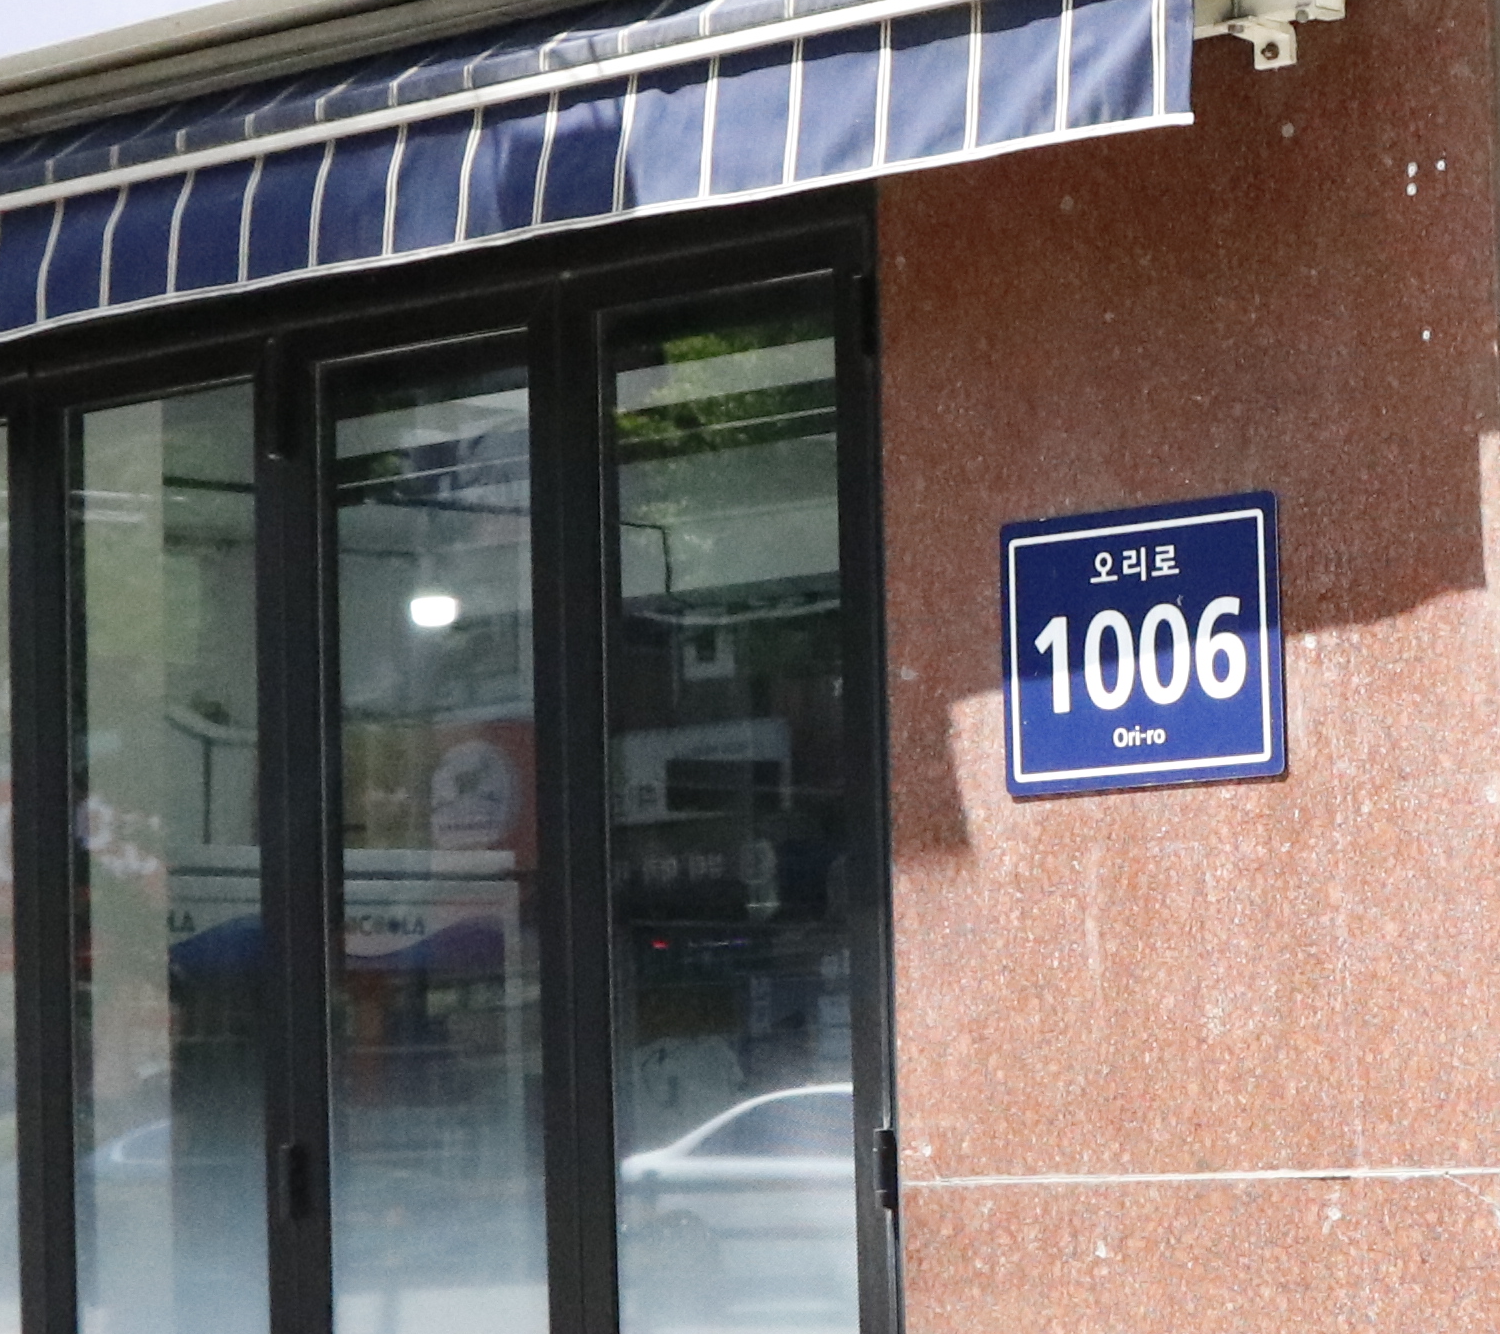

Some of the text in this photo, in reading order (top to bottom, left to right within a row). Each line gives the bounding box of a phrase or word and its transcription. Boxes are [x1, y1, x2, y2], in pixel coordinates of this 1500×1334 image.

[1089, 544, 1181, 584] 오리로
[1033, 595, 1248, 715] 1006
[1112, 725, 1167, 749] Ori-ro
